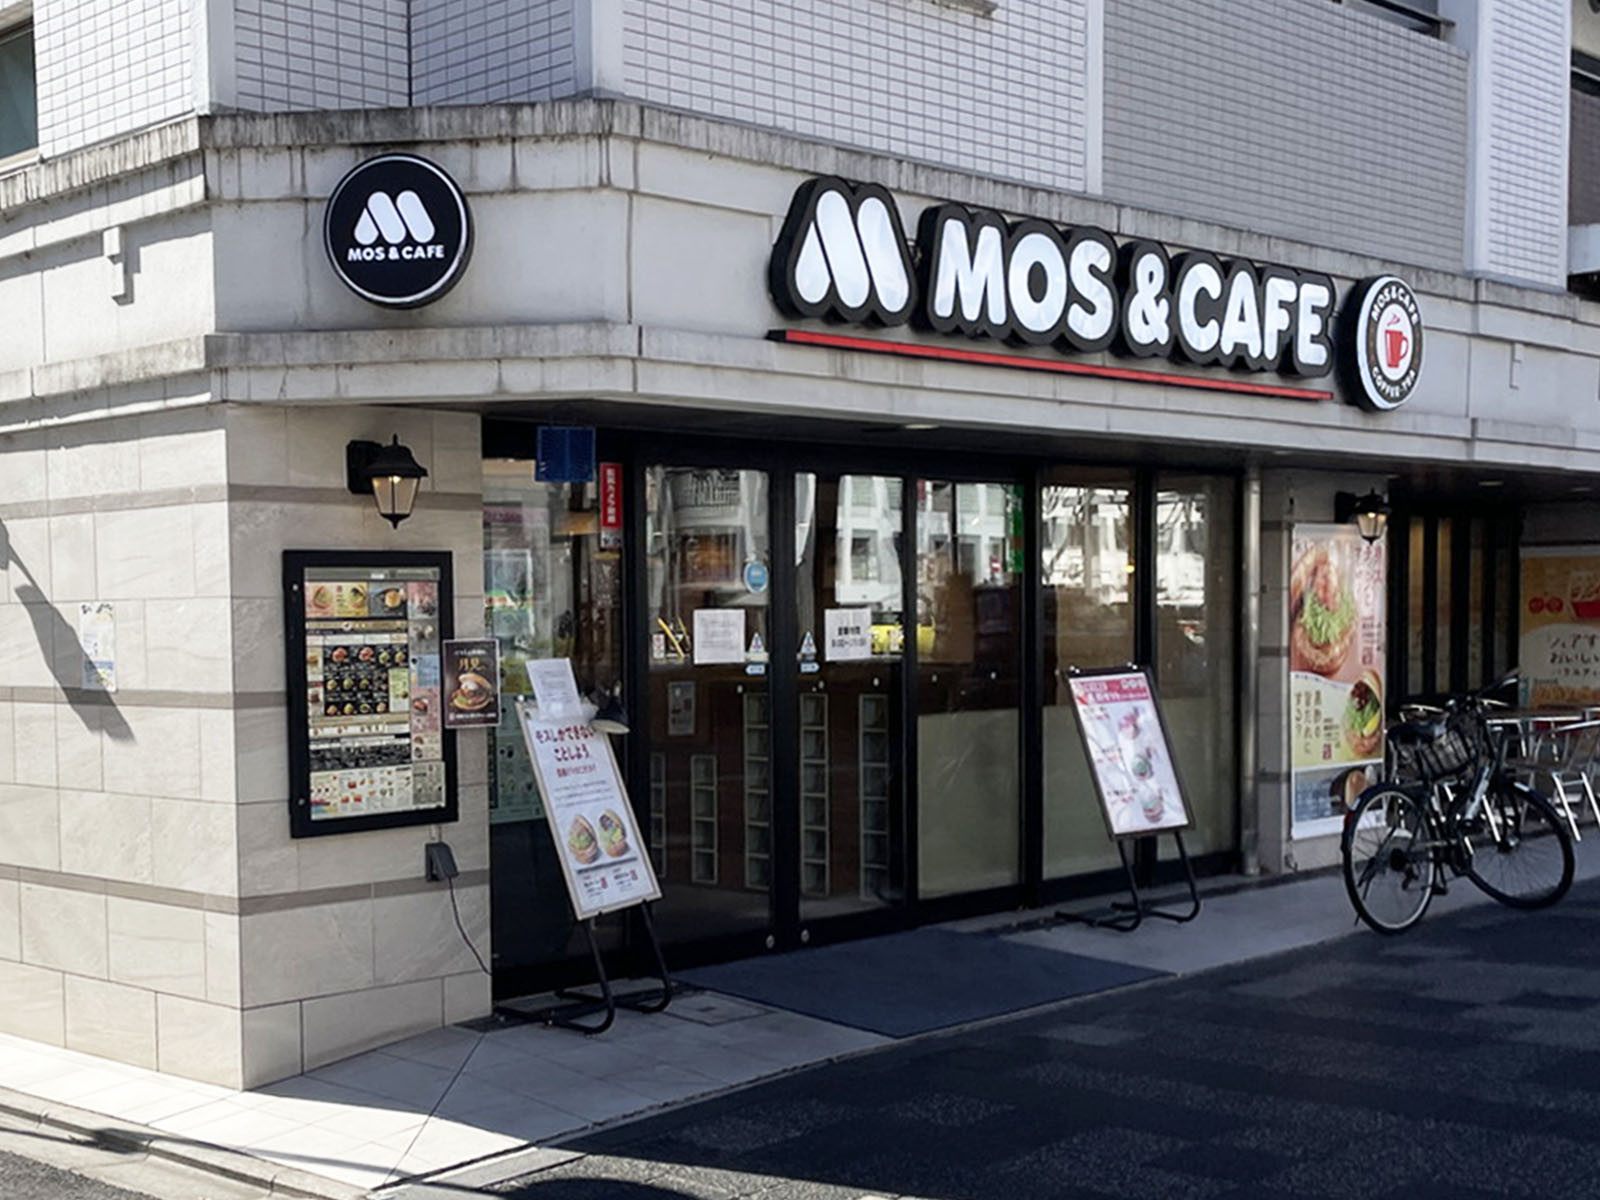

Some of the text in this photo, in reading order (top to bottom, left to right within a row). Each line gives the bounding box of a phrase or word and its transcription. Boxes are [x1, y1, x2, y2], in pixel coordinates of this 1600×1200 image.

[347, 247, 385, 261] MOS
[401, 245, 445, 259] CAFE
[934, 218, 1114, 340] MOS
[1178, 262, 1330, 366] CAFE
